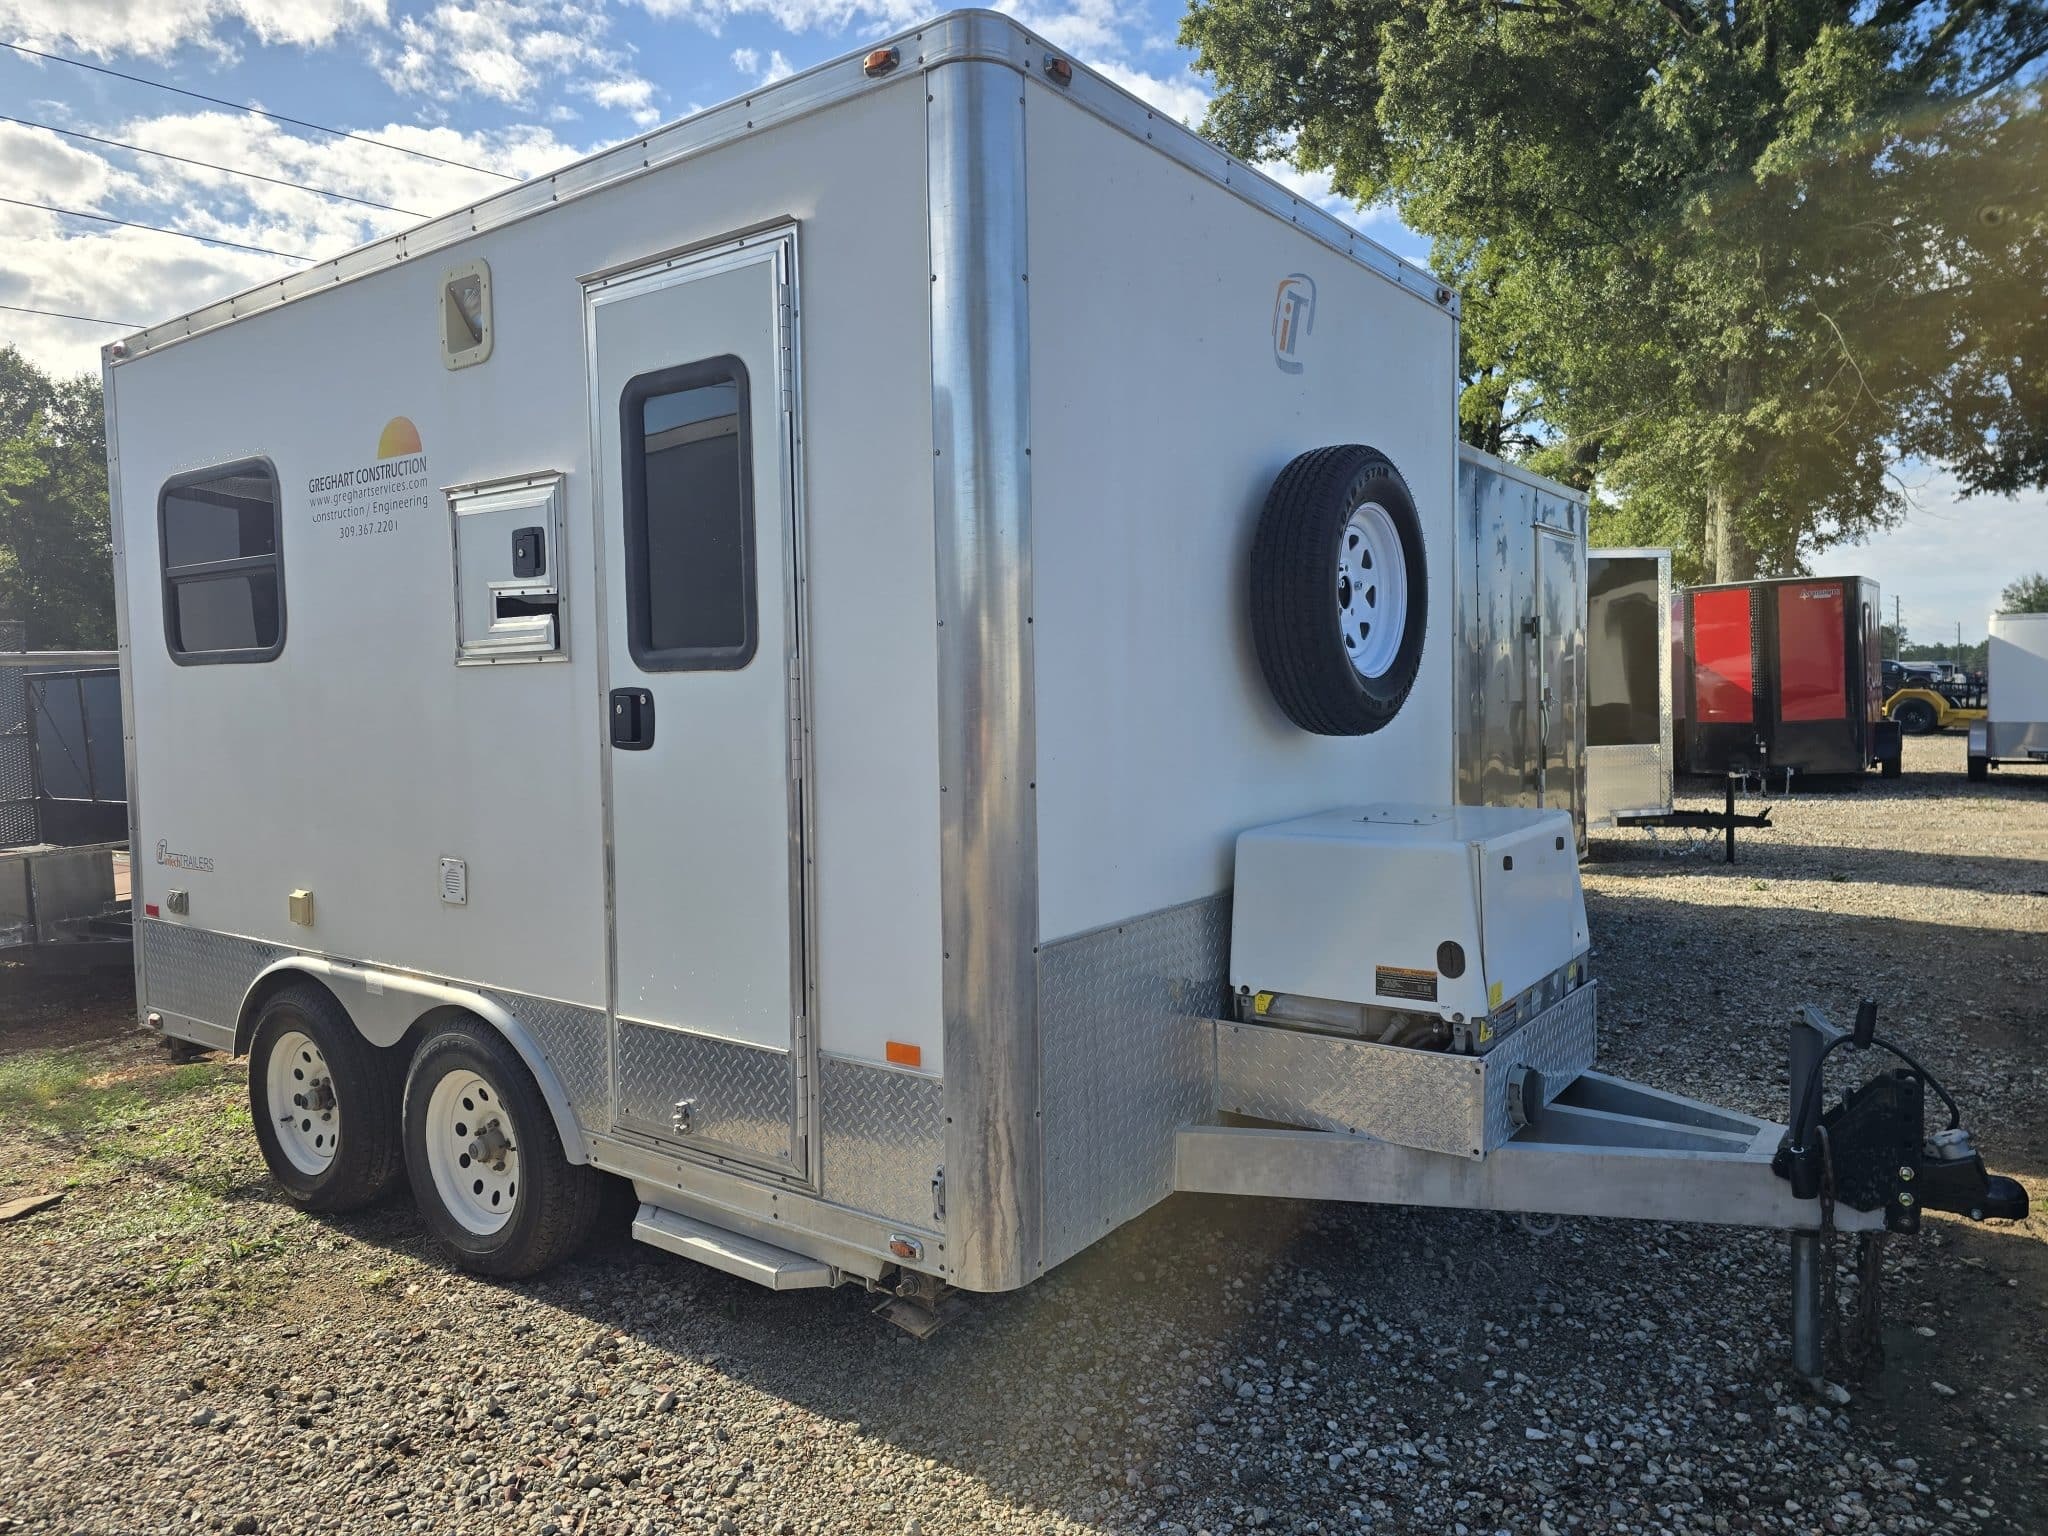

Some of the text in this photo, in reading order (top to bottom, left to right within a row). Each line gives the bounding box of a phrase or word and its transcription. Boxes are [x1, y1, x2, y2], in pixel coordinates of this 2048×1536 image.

[309, 456, 427, 493] GREGHART CONSTRUCTION
[309, 478, 428, 507] www.greghartservices.com
[312, 506, 364, 523] construction
[373, 495, 428, 514] Engineering
[339, 520, 398, 539] 309.367.2201
